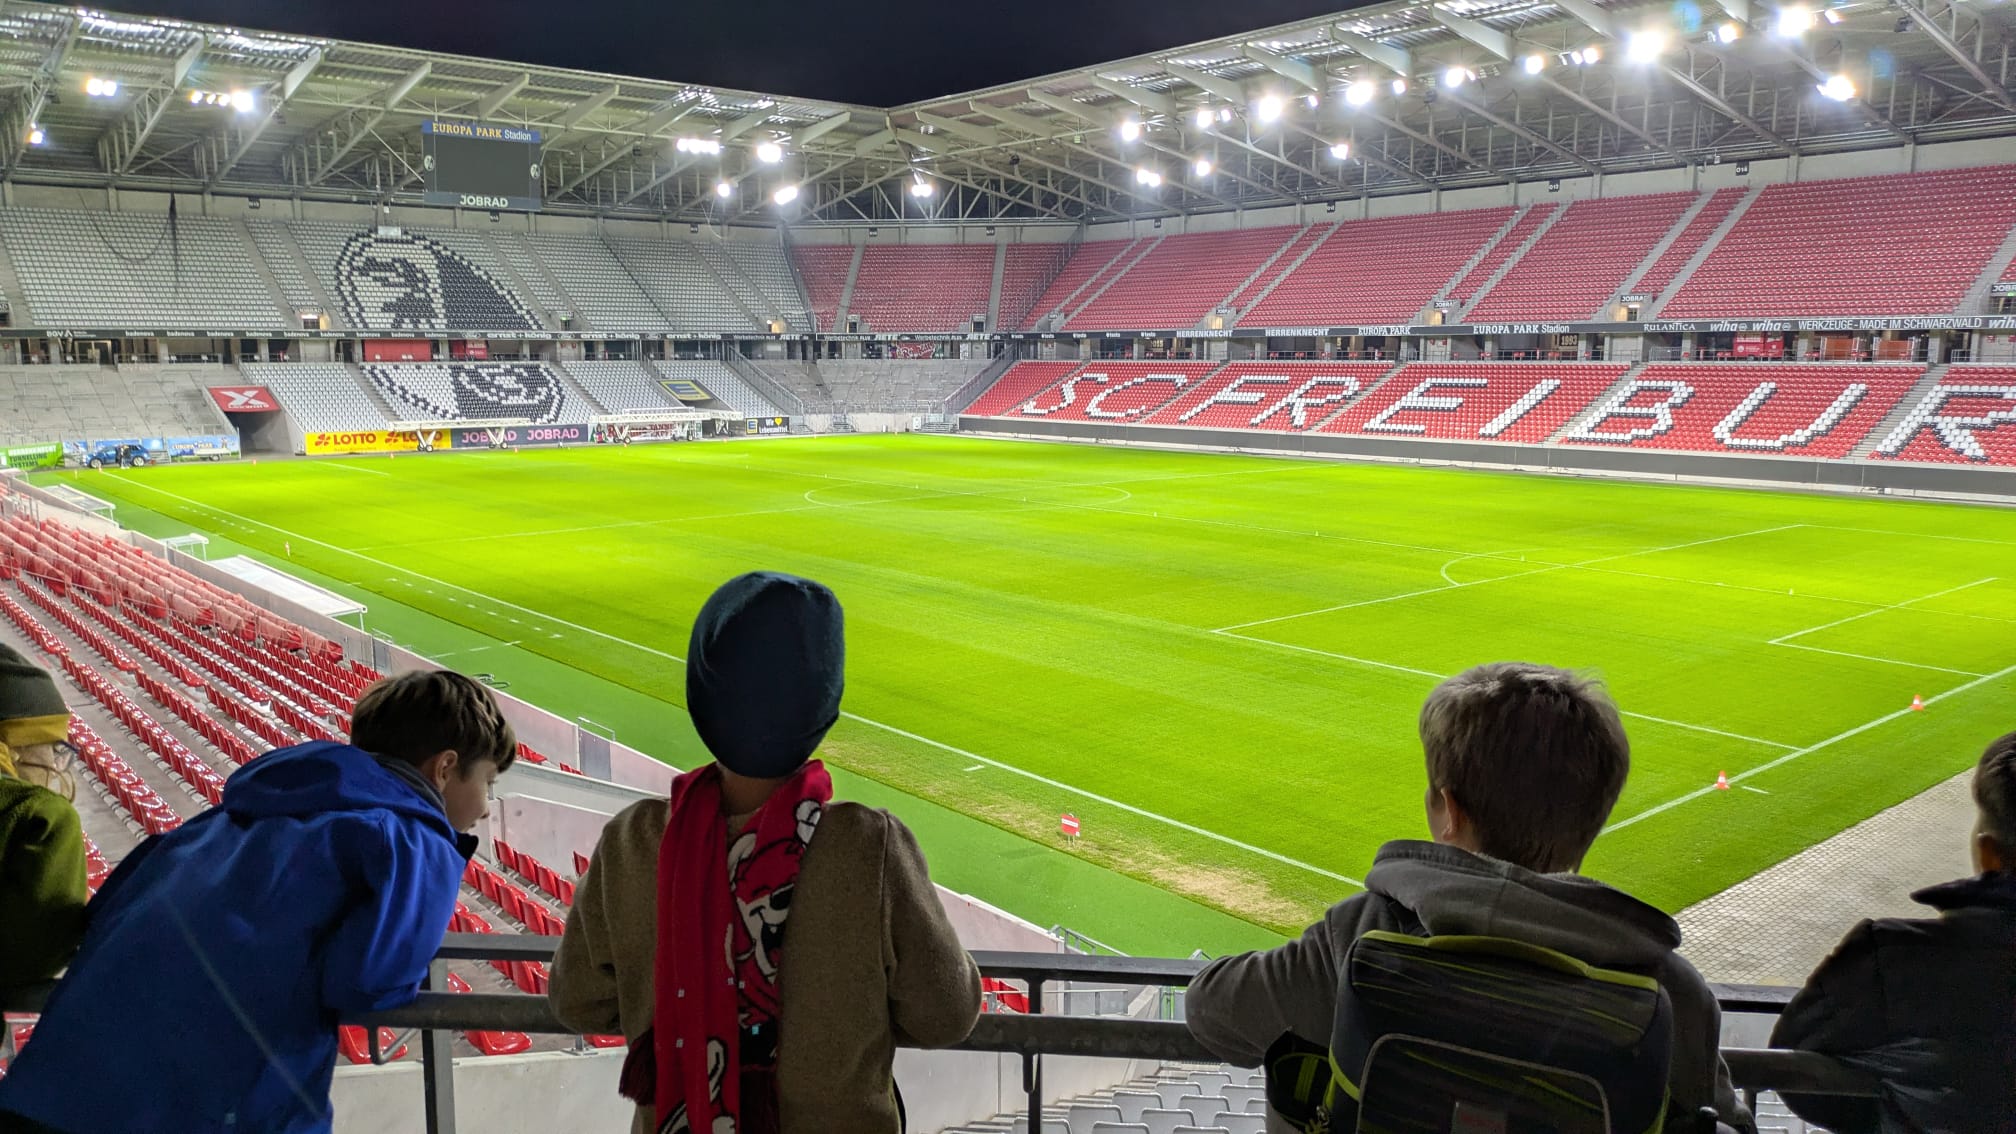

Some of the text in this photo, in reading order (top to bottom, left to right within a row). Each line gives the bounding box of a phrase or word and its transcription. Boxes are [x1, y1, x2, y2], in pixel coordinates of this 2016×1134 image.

[432, 123, 532, 141] EUROPA PARK Stadion
[459, 195, 509, 208] JOBRAD
[1709, 320, 1738, 332] wiha
[1752, 320, 1781, 332] wiha
[1798, 319, 1853, 330] WERKZEUGE
[1859, 319, 1887, 329] MADE
[1889, 319, 1901, 329] IM
[1903, 318, 1982, 329] SCHWARZWALD
[1988, 316, 2016, 329] wih
[1176, 329, 1233, 338] HERRENKNECHT
[1265, 328, 1329, 337] HERRENKNECHT
[1358, 326, 1411, 336] EUROPA PARK
[1473, 324, 1570, 335] EUROPA PARK Stadion
[1021, 372, 1189, 419] SC
[333, 432, 377, 445] LOTTO
[462, 430, 518, 443] JOBD
[527, 428, 580, 441] JOBRAD
